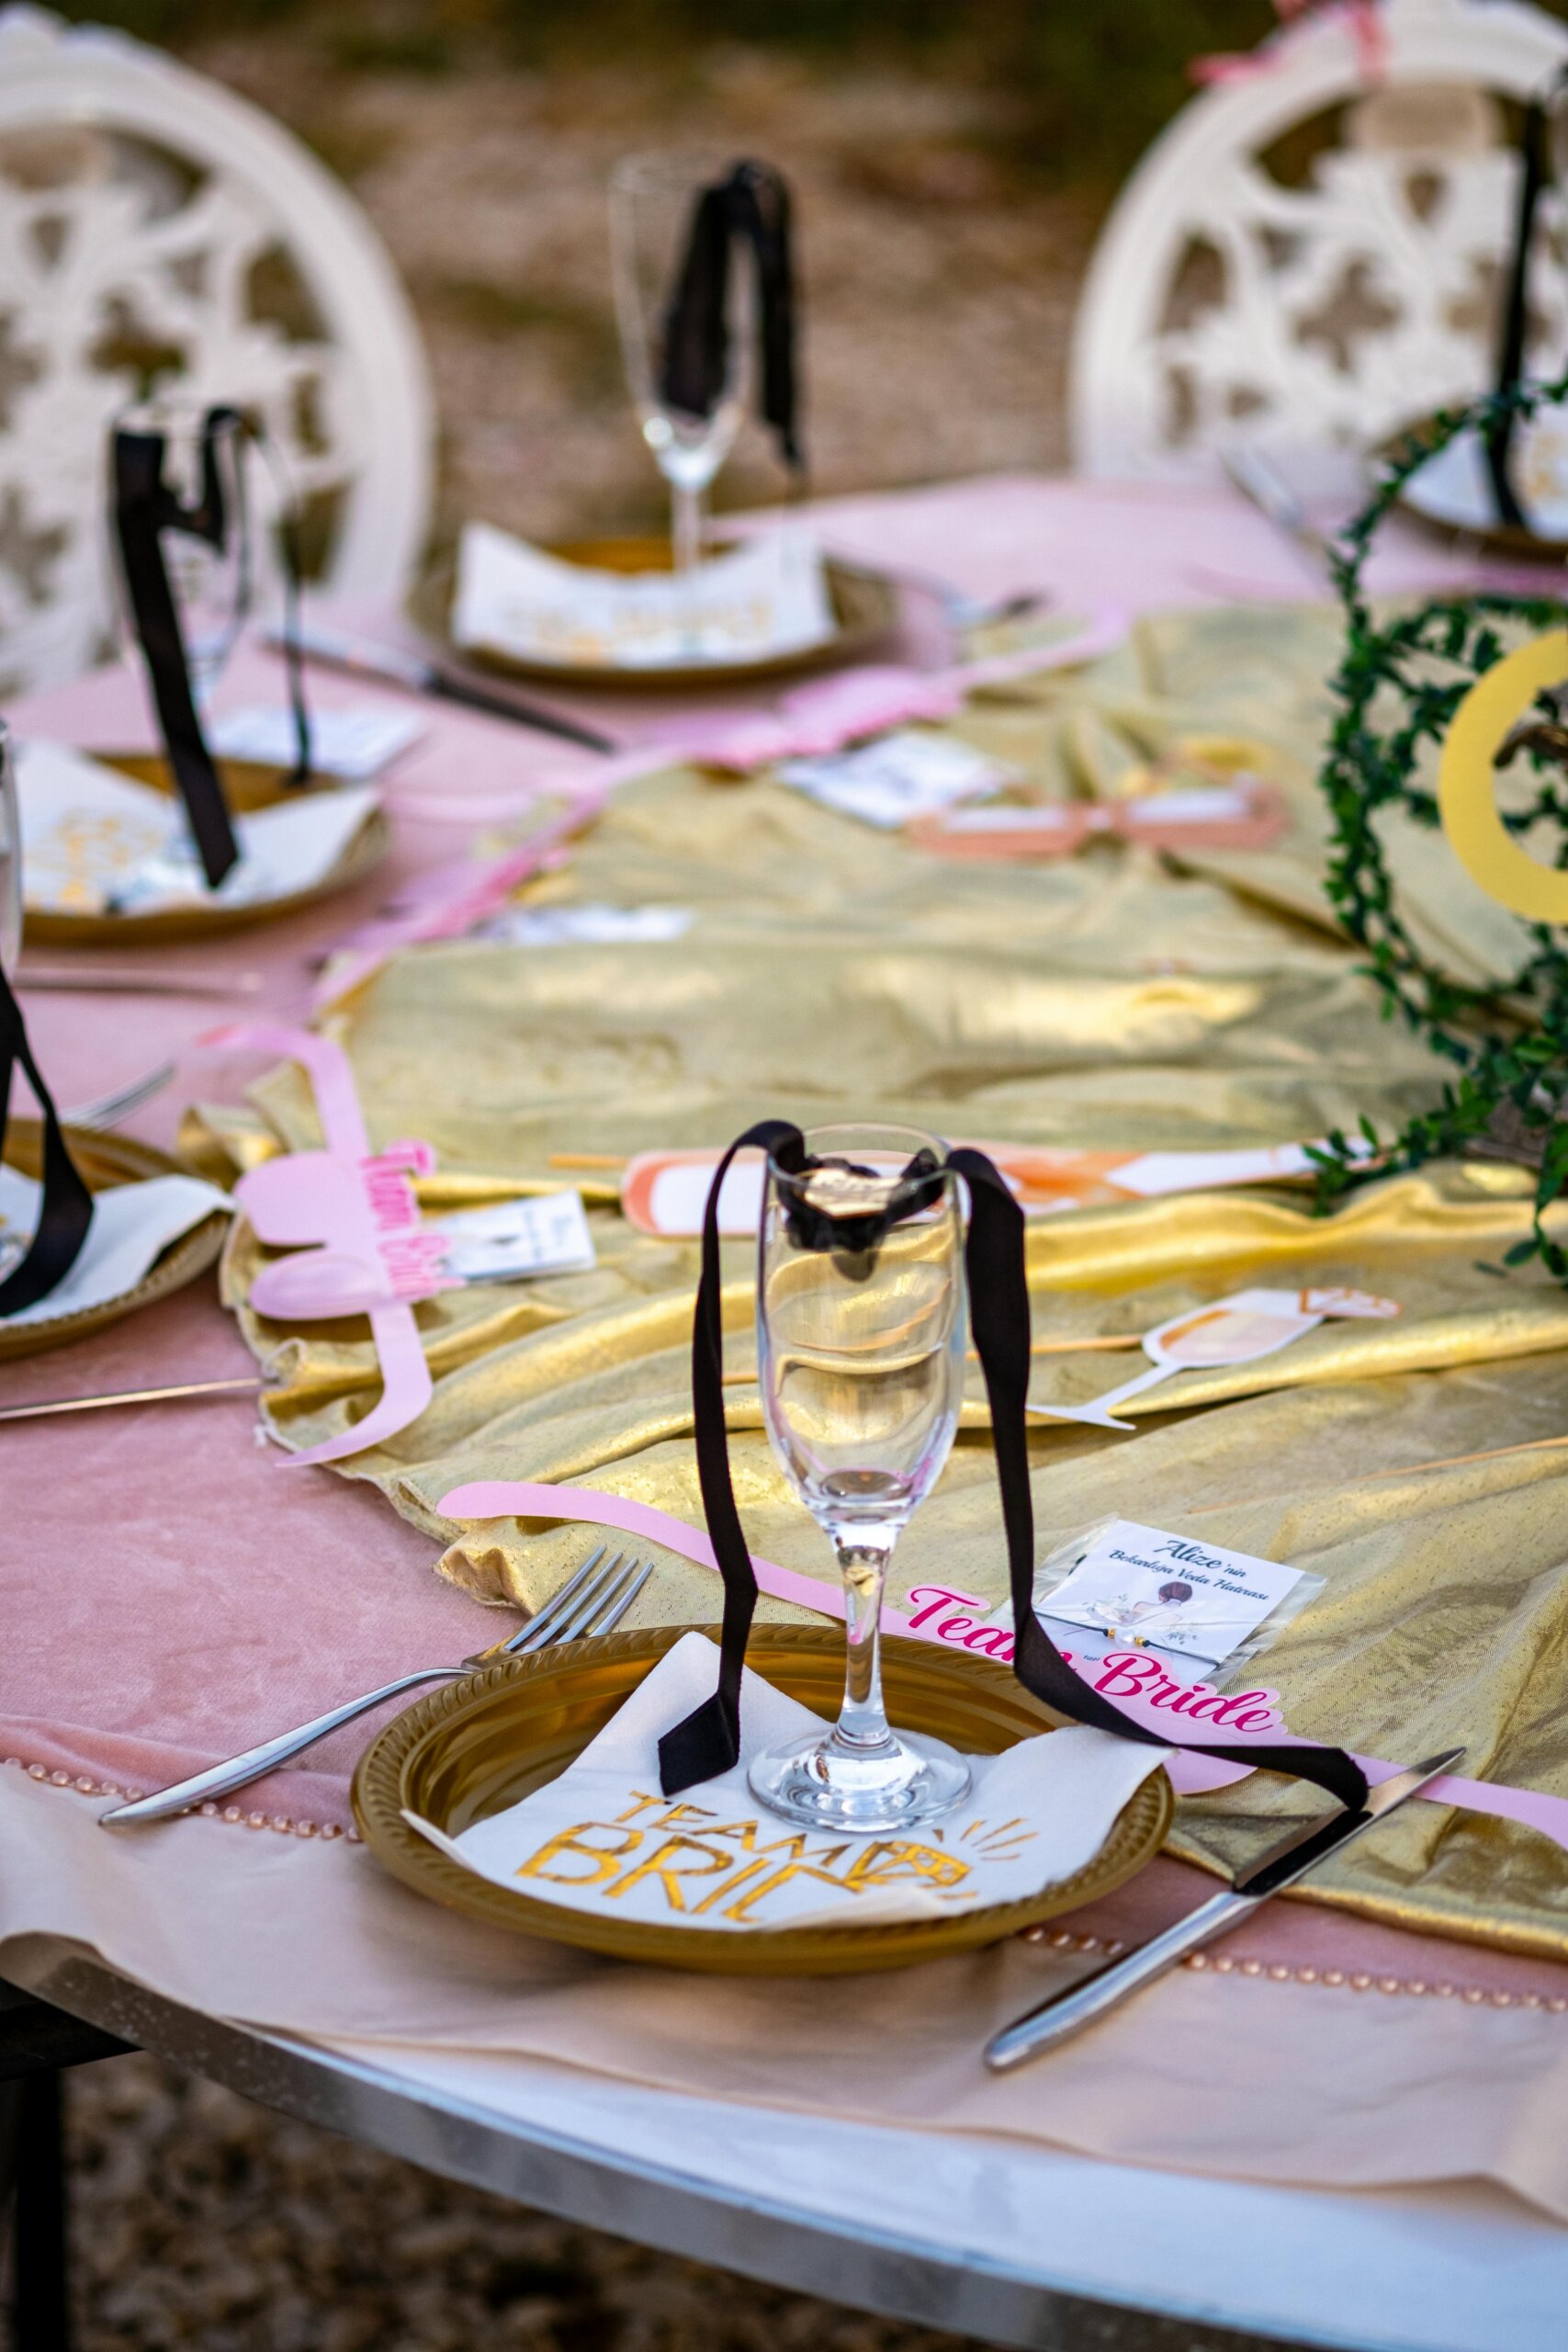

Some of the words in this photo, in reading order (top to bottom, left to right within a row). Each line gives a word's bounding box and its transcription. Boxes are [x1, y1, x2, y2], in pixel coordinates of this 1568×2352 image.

[1153, 1540, 1223, 1570] Alize
[1178, 1568, 1210, 1586] Veda
[1094, 1653, 1274, 1733] Bride
[613, 1790, 854, 1867] TEAM
